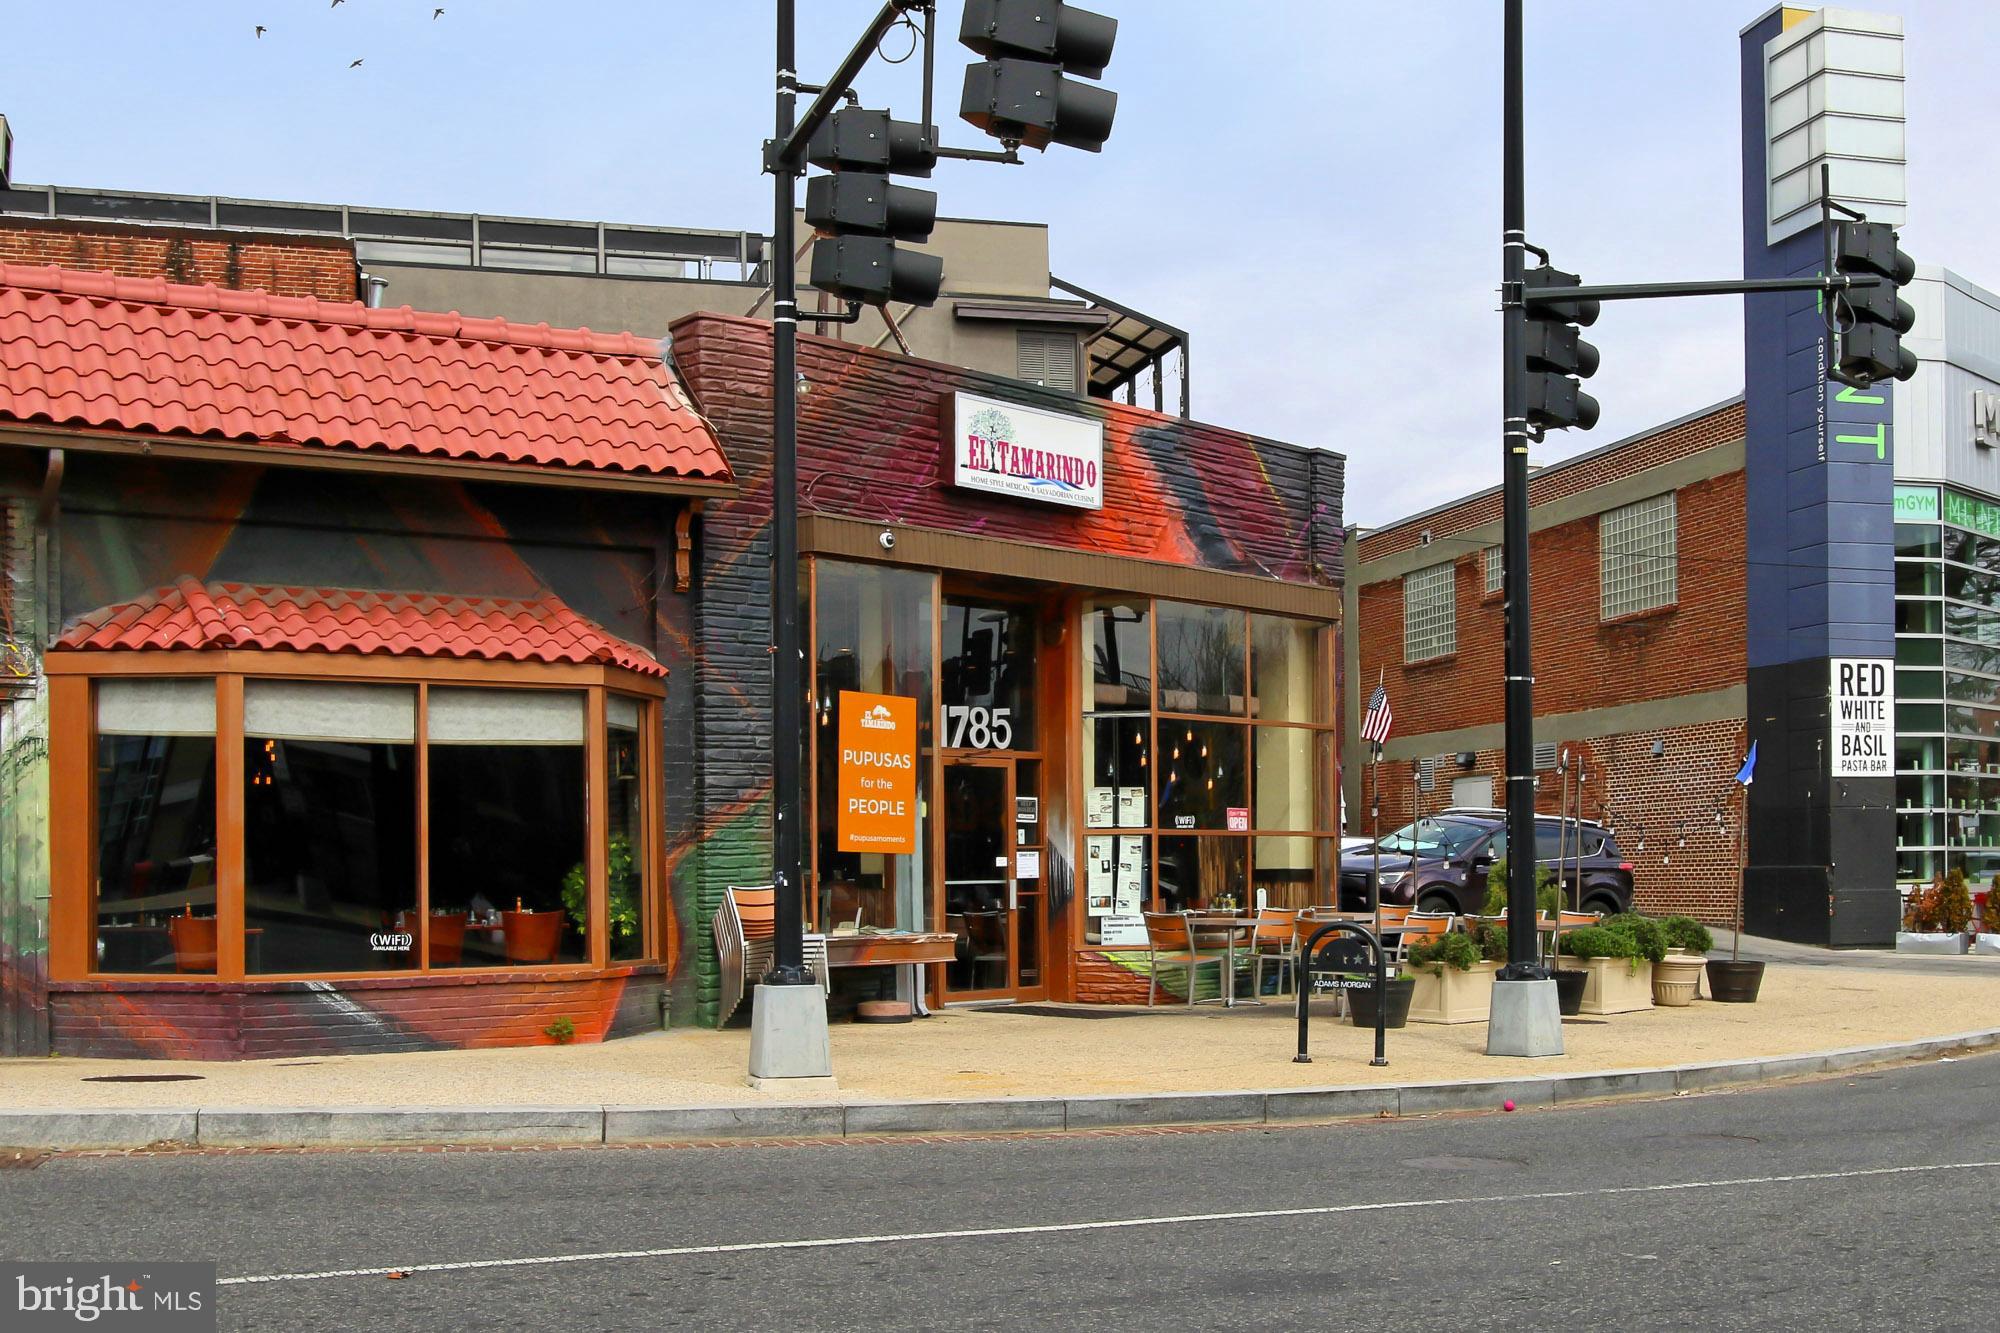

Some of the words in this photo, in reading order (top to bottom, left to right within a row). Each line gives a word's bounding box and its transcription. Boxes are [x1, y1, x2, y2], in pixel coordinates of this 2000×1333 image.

[1818, 337, 1826, 401] condition
[1817, 406, 1826, 462] yourself
[968, 435, 989, 470] EL
[998, 441, 1097, 488] TAMARINDO
[970, 475, 988, 485] HOME
[989, 479, 1004, 488] STYLE
[1005, 481, 1030, 492] MEXICAN
[1031, 485, 1036, 493] &
[1036, 487, 1074, 499] SALVADORIAN
[1074, 493, 1095, 504] CUISINE
[1840, 663, 1885, 697] RED
[1840, 700, 1885, 720] WHITE
[941, 704, 1012, 750] 1785
[1855, 722, 1871, 733] AND
[1841, 734, 1887, 757] BASIL
[843, 749, 911, 769] PUPUSAS
[1841, 759, 1868, 772] PASTA
[1870, 759, 1887, 772] BAR
[860, 776, 874, 789] for
[876, 778, 893, 790] the
[848, 798, 905, 816] PEOPLE
[849, 833, 906, 844] #pupusamoments
[1313, 980, 1339, 988] ADAMS
[1340, 981, 1371, 989] MORGAN
